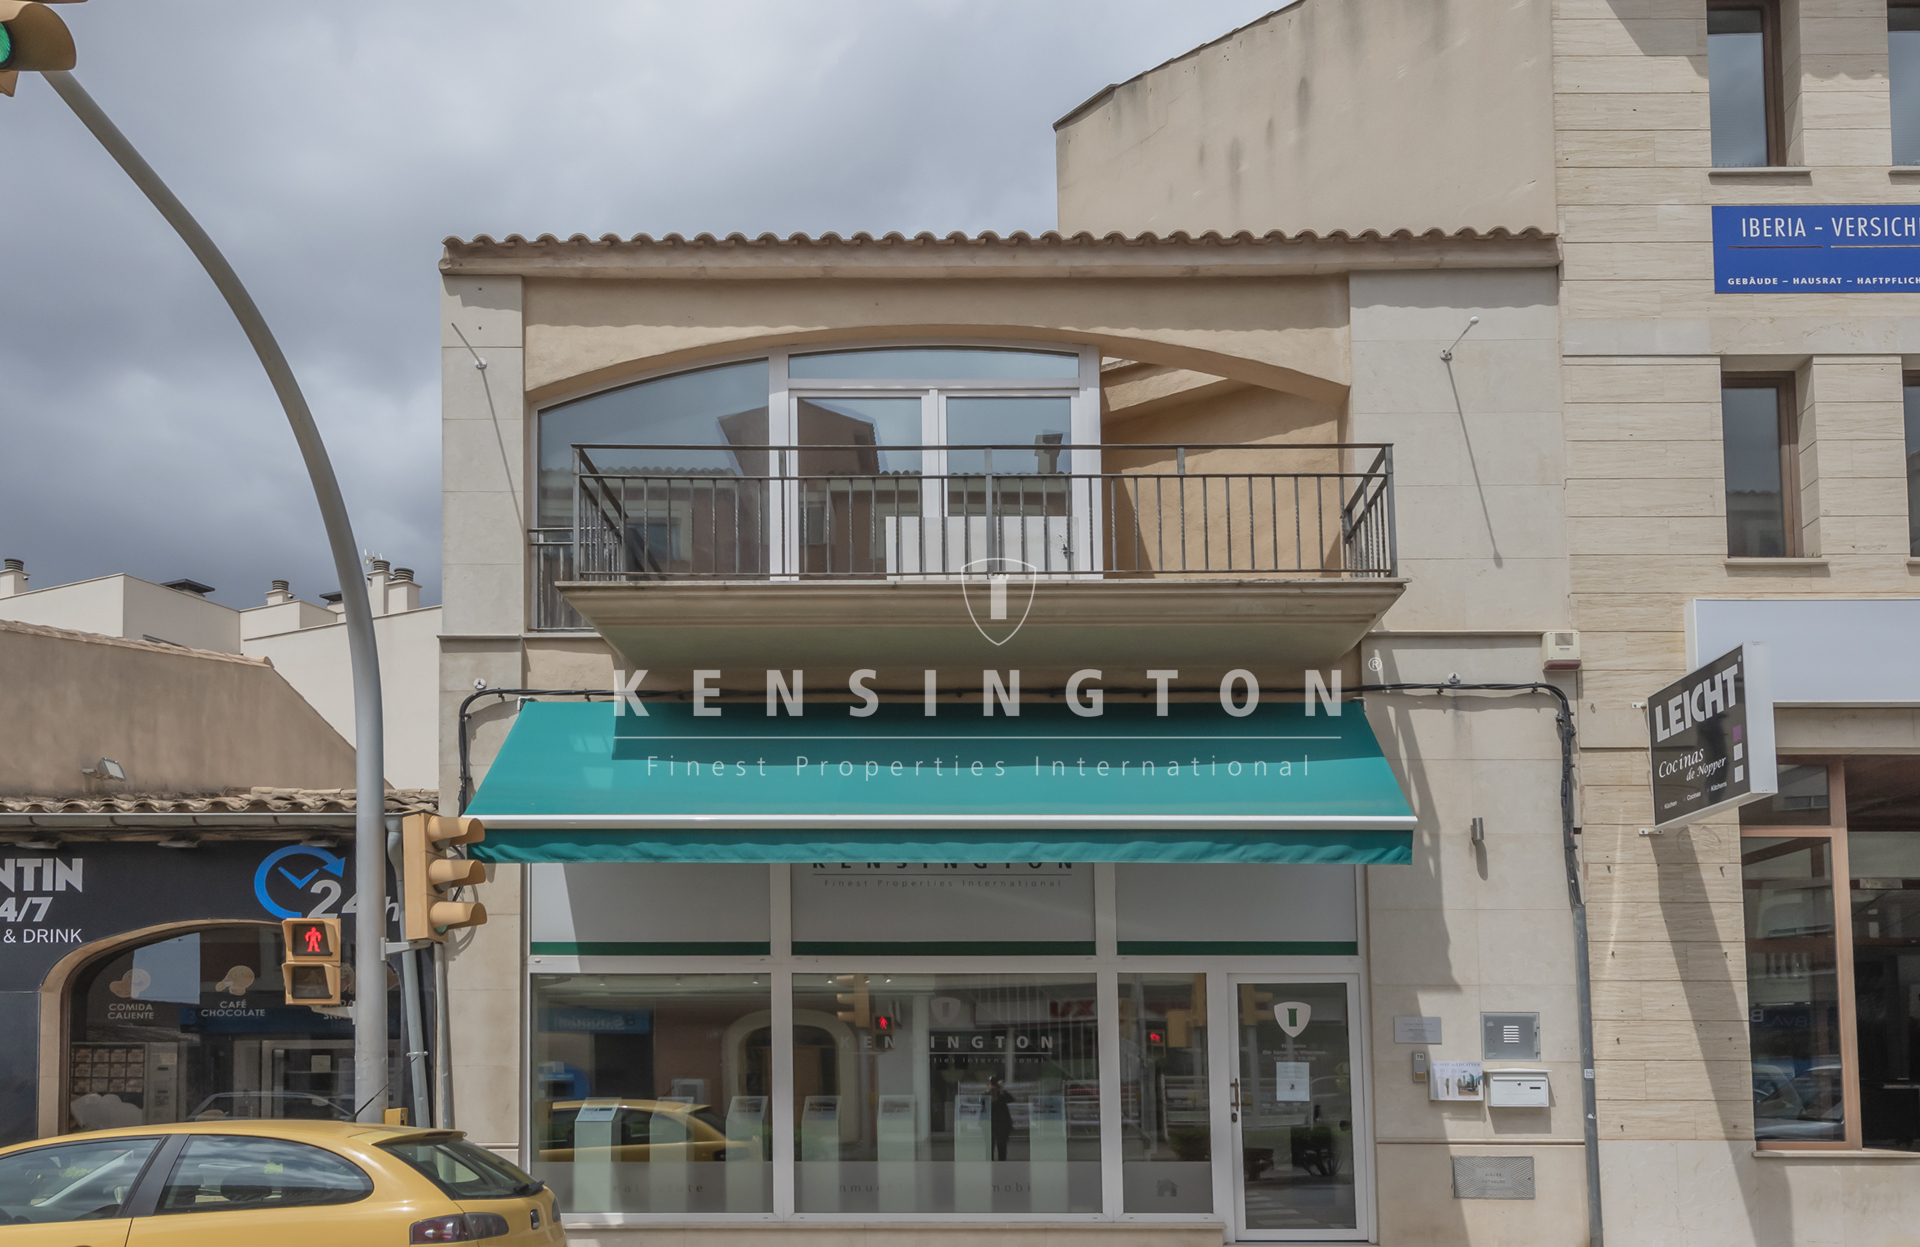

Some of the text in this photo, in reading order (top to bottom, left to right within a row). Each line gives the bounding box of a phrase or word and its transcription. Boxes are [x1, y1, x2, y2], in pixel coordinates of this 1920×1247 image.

[1741, 217, 1807, 238] IBERIA
[1831, 217, 1920, 238] VERSICH
[1727, 276, 1778, 285] GEBÄUDE
[1793, 277, 1843, 285] HAUSRAT
[1655, 664, 1739, 743] LEICHT
[1658, 748, 1704, 778] Cocinas
[1686, 757, 1727, 781] de Nopper
[824, 879, 1062, 889] Finest Properties International
[0, 896, 53, 923] 4/7
[3, 929, 83, 943] & DRINK
[108, 1003, 154, 1011] COMIDA
[219, 999, 247, 1009] CAFÉ
[107, 1012, 155, 1020] CALIENTE
[200, 1009, 266, 1017] CHOCOLATE
[840, 1035, 1053, 1049] KENINGTON
